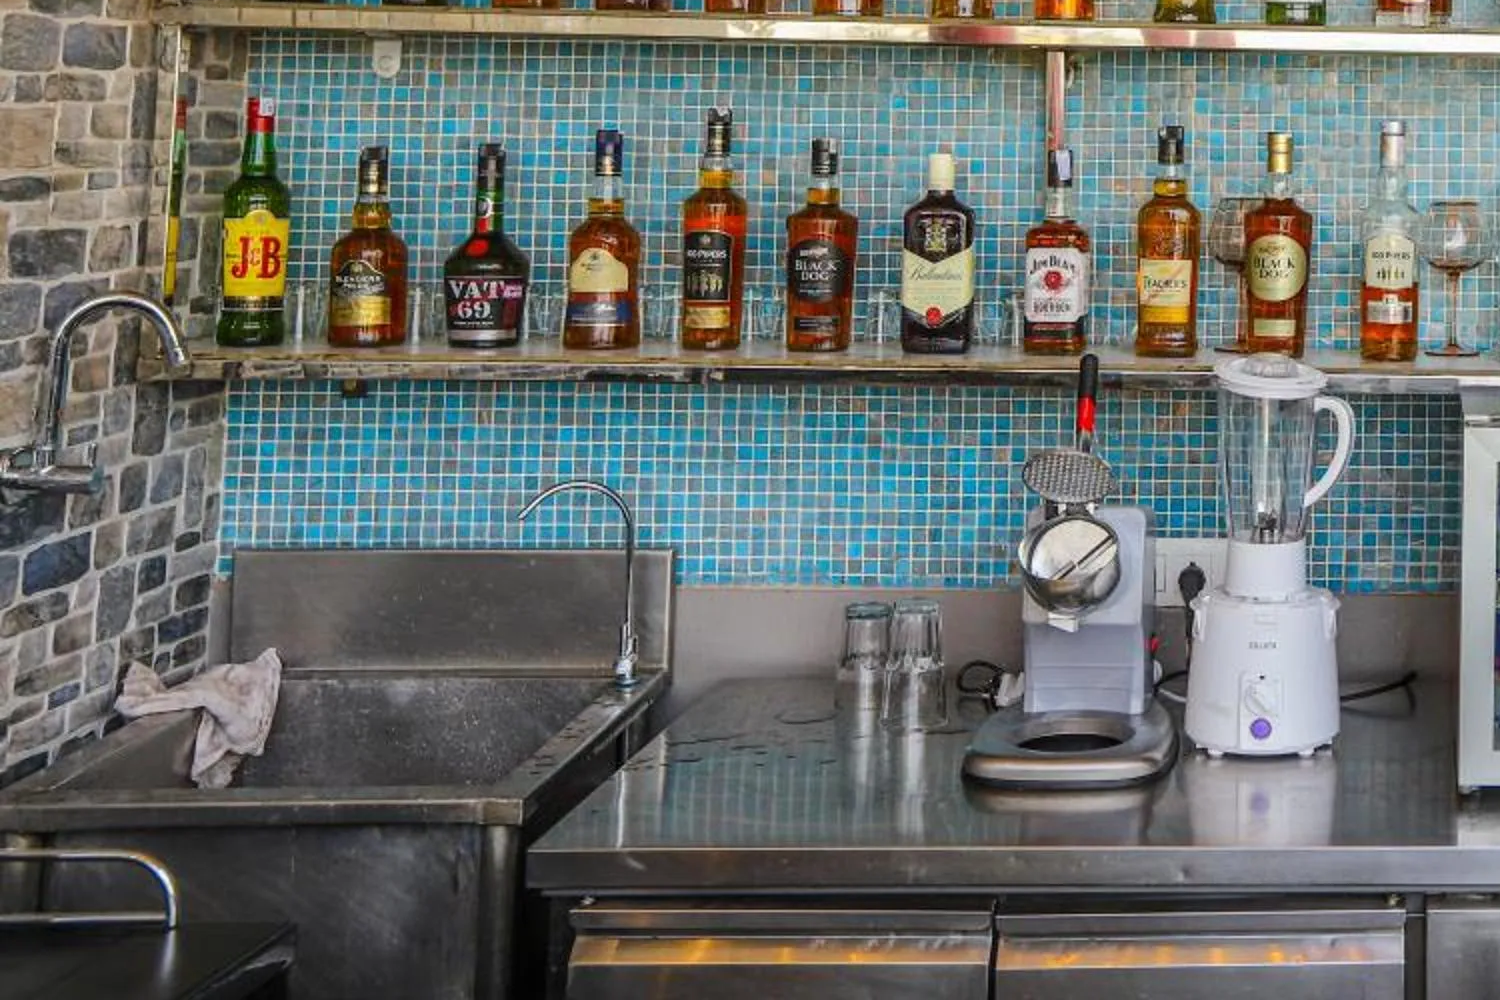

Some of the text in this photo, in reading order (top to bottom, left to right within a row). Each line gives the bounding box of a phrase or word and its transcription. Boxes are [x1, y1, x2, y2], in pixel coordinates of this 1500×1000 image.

[231, 235, 282, 280] J&B
[795, 259, 837, 272] BLACK
[448, 279, 505, 299] VAT
